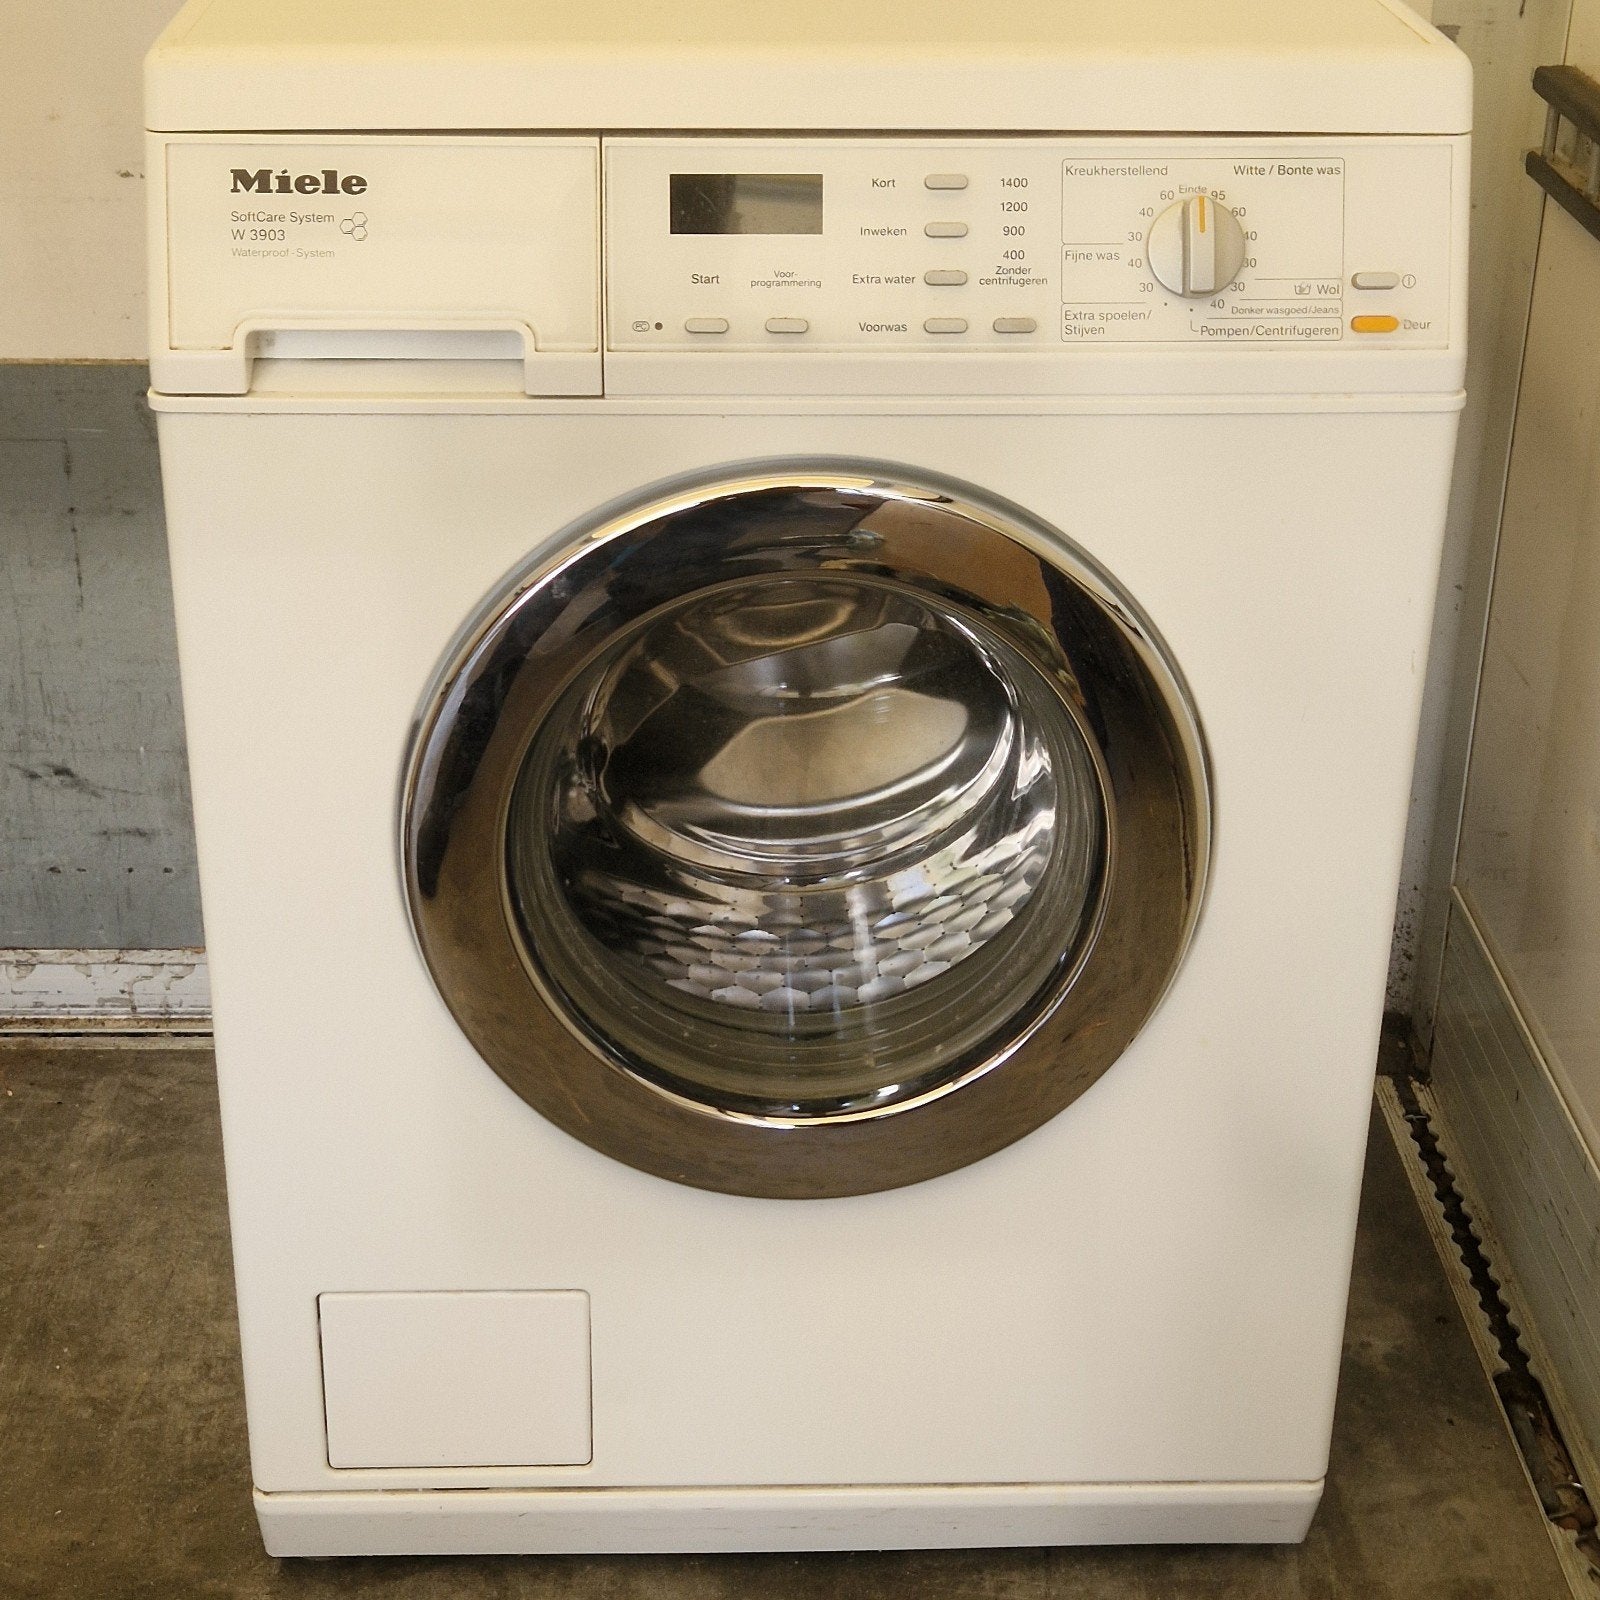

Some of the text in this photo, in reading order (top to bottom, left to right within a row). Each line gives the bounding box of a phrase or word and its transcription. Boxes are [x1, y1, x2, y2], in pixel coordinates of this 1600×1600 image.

[1064, 165, 1169, 176] Kreukherstellend
[1233, 165, 1267, 175] Witte
[1277, 165, 1314, 175] Bonte
[1316, 167, 1341, 175] was
[230, 168, 368, 195] Miele
[871, 178, 896, 188] Kort
[1000, 178, 1028, 188] 1400
[1178, 184, 1208, 194] Einde
[1159, 190, 1175, 201] 60
[1211, 191, 1226, 201] 95
[1000, 202, 1028, 212] 1200
[1138, 207, 1154, 217] 40
[1231, 207, 1247, 217] 60
[231, 211, 335, 225] SoftCare System
[231, 229, 286, 241] W 3903
[860, 226, 907, 236] Inweken
[1002, 226, 1025, 236] 900
[1127, 232, 1143, 242] 30
[1002, 250, 1025, 260] 400
[1064, 250, 1120, 263] Fijne was
[1127, 258, 1142, 268] 40
[773, 270, 798, 278] Voor-
[995, 266, 1032, 275] Zonder
[691, 273, 720, 284] Start
[750, 278, 822, 289] programmering
[852, 274, 916, 284] Extra water
[979, 275, 1048, 287] centrifugeren
[1139, 282, 1154, 293] 30
[1230, 282, 1246, 292] 30
[1316, 284, 1340, 295] Wol
[1210, 299, 1225, 309] 40
[1231, 305, 1340, 316] Donker wasgoed/Jeans
[1064, 310, 1152, 322] Extra spoelen/
[858, 322, 908, 332] Voorwas
[1403, 319, 1431, 330] Deur
[1064, 324, 1105, 337] Stijven
[1200, 325, 1339, 338] Pompen/Centrifugeren
